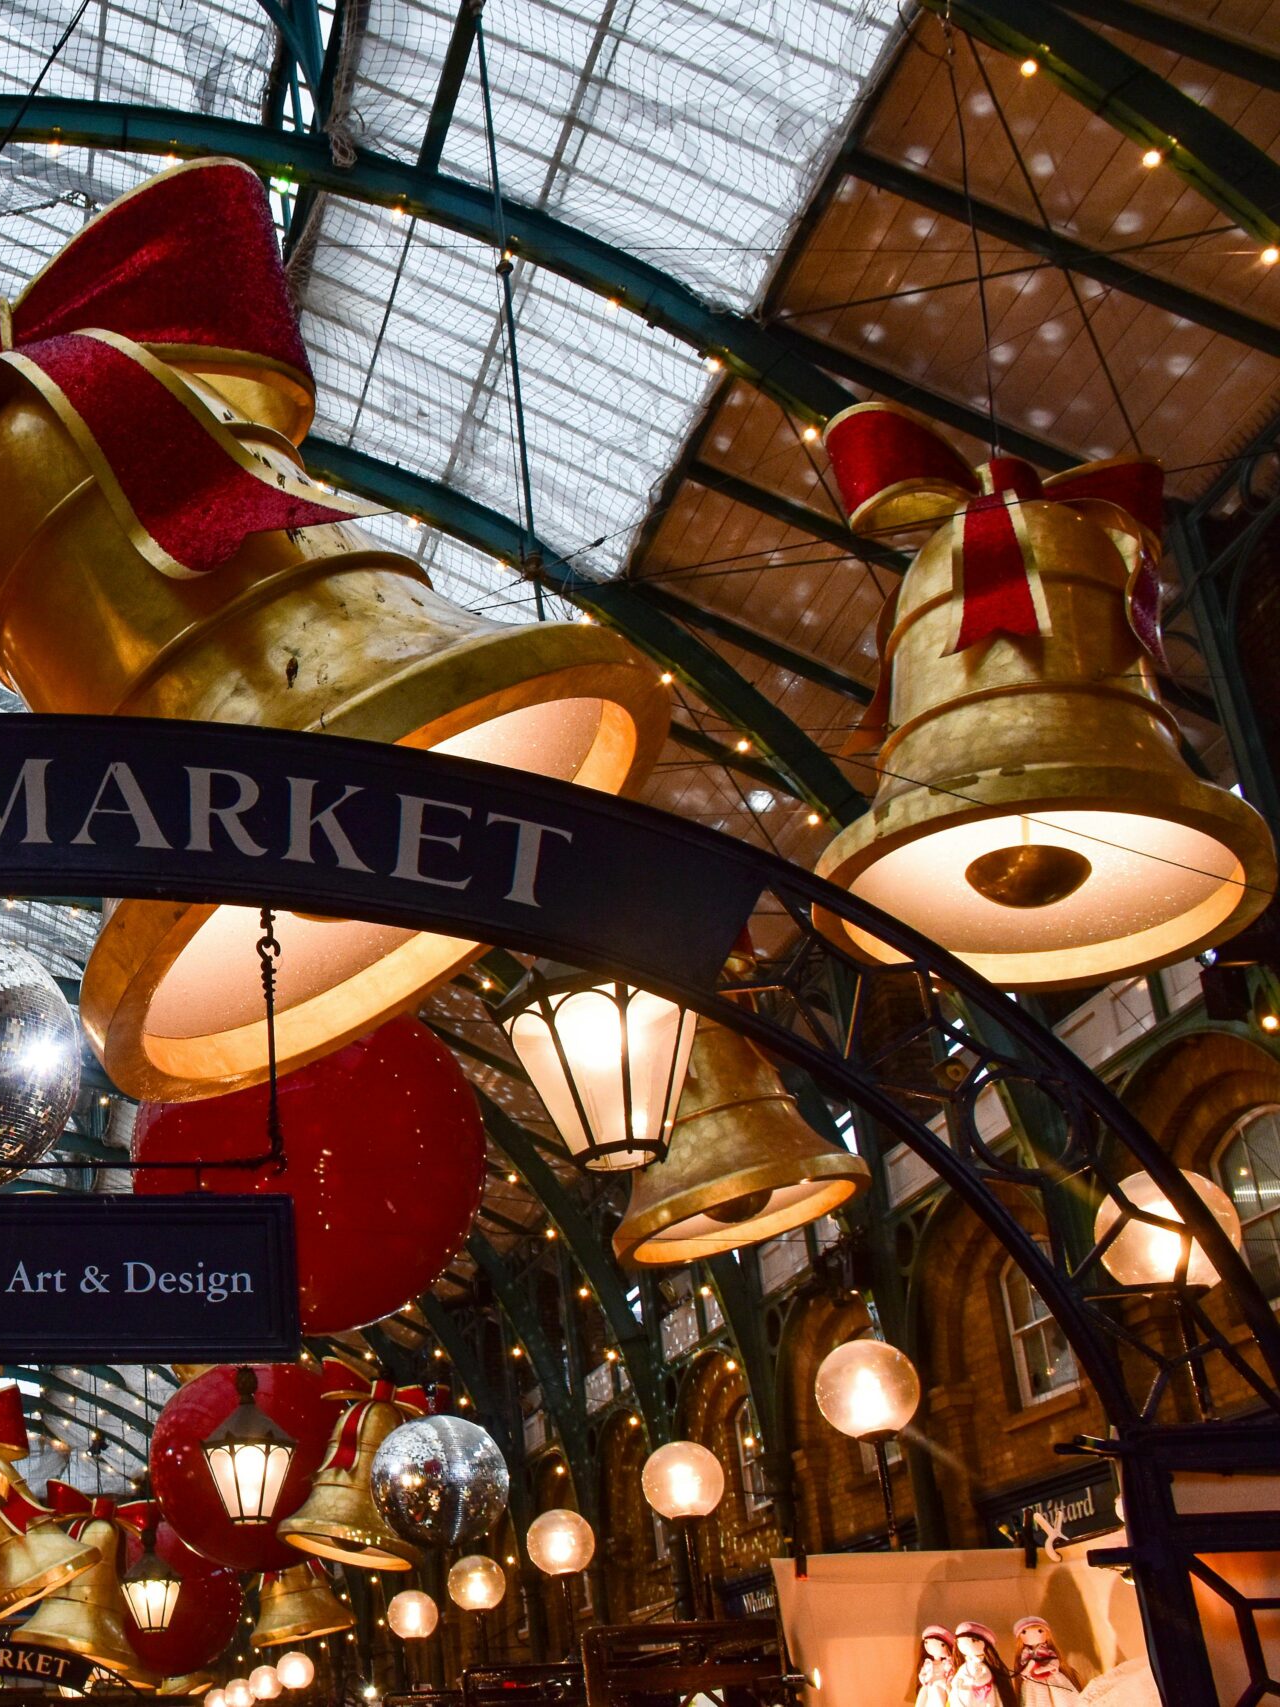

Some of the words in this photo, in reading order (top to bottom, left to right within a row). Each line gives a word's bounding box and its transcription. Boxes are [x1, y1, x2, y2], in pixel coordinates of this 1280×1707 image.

[5, 1259, 67, 1294] Art
[79, 1264, 110, 1294] &
[123, 1260, 254, 1303] Design
